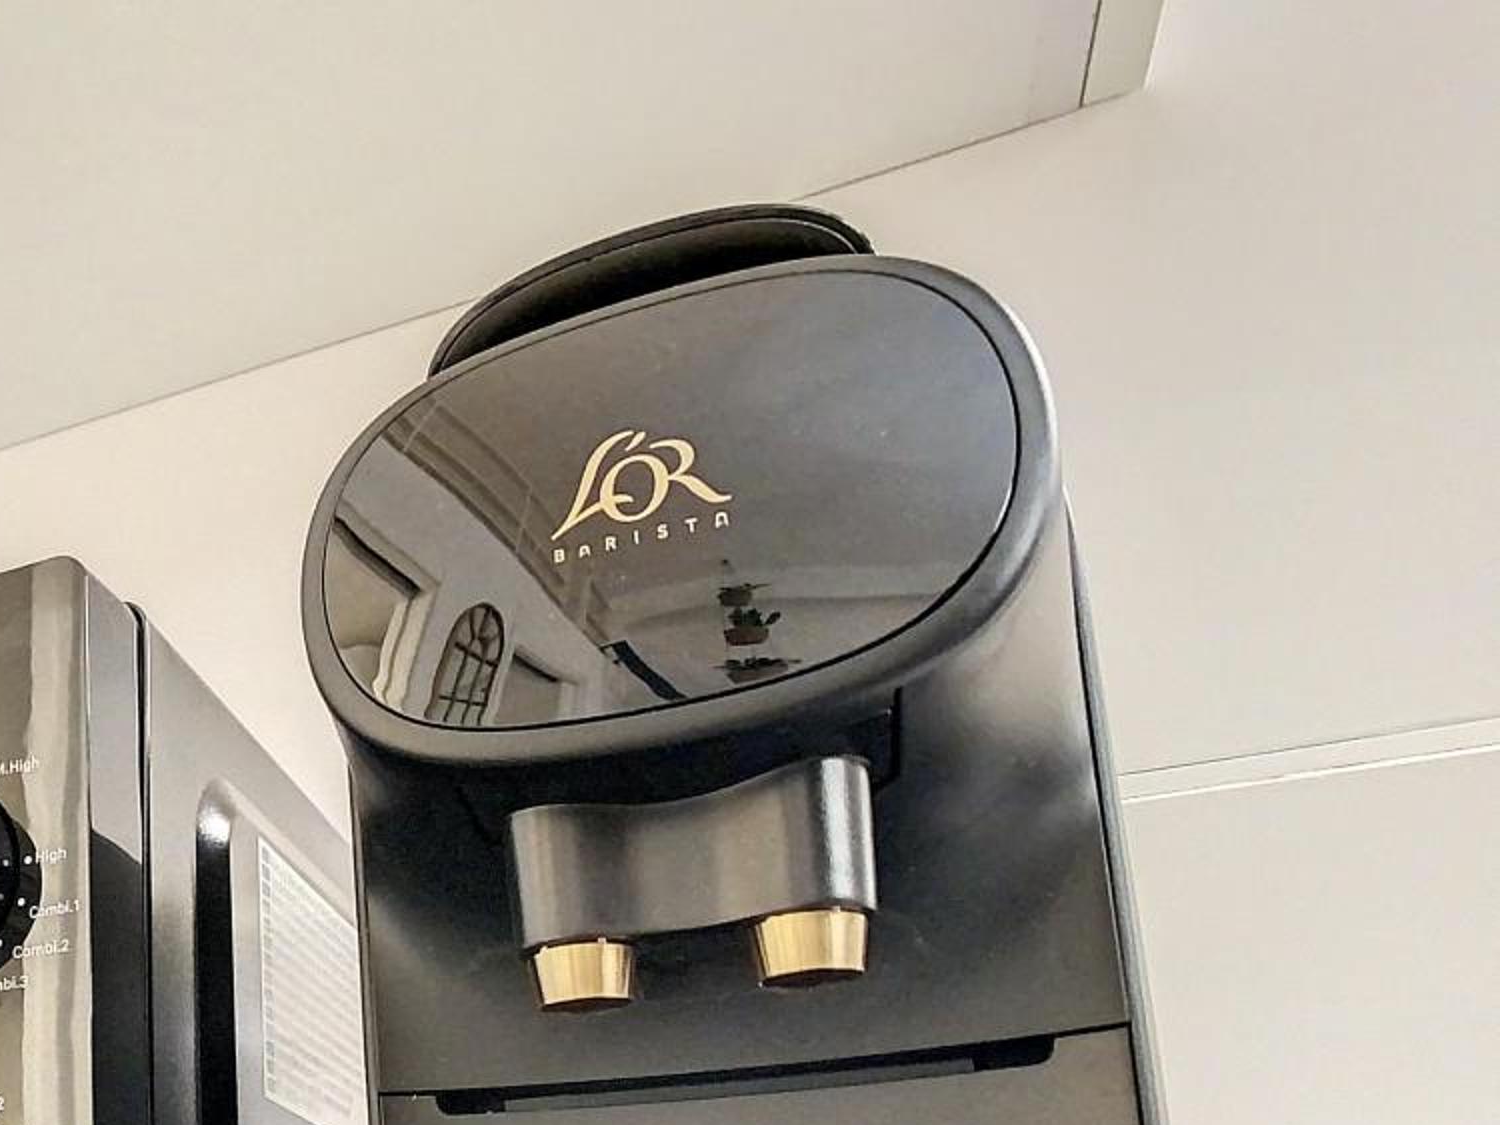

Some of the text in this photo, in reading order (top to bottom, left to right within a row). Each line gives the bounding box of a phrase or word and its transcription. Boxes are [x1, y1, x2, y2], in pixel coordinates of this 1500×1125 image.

[554, 511, 732, 563] BARISTA
[35, 847, 67, 865] High
[29, 899, 80, 919] Combi.1
[12, 939, 70, 959] Combi.2
